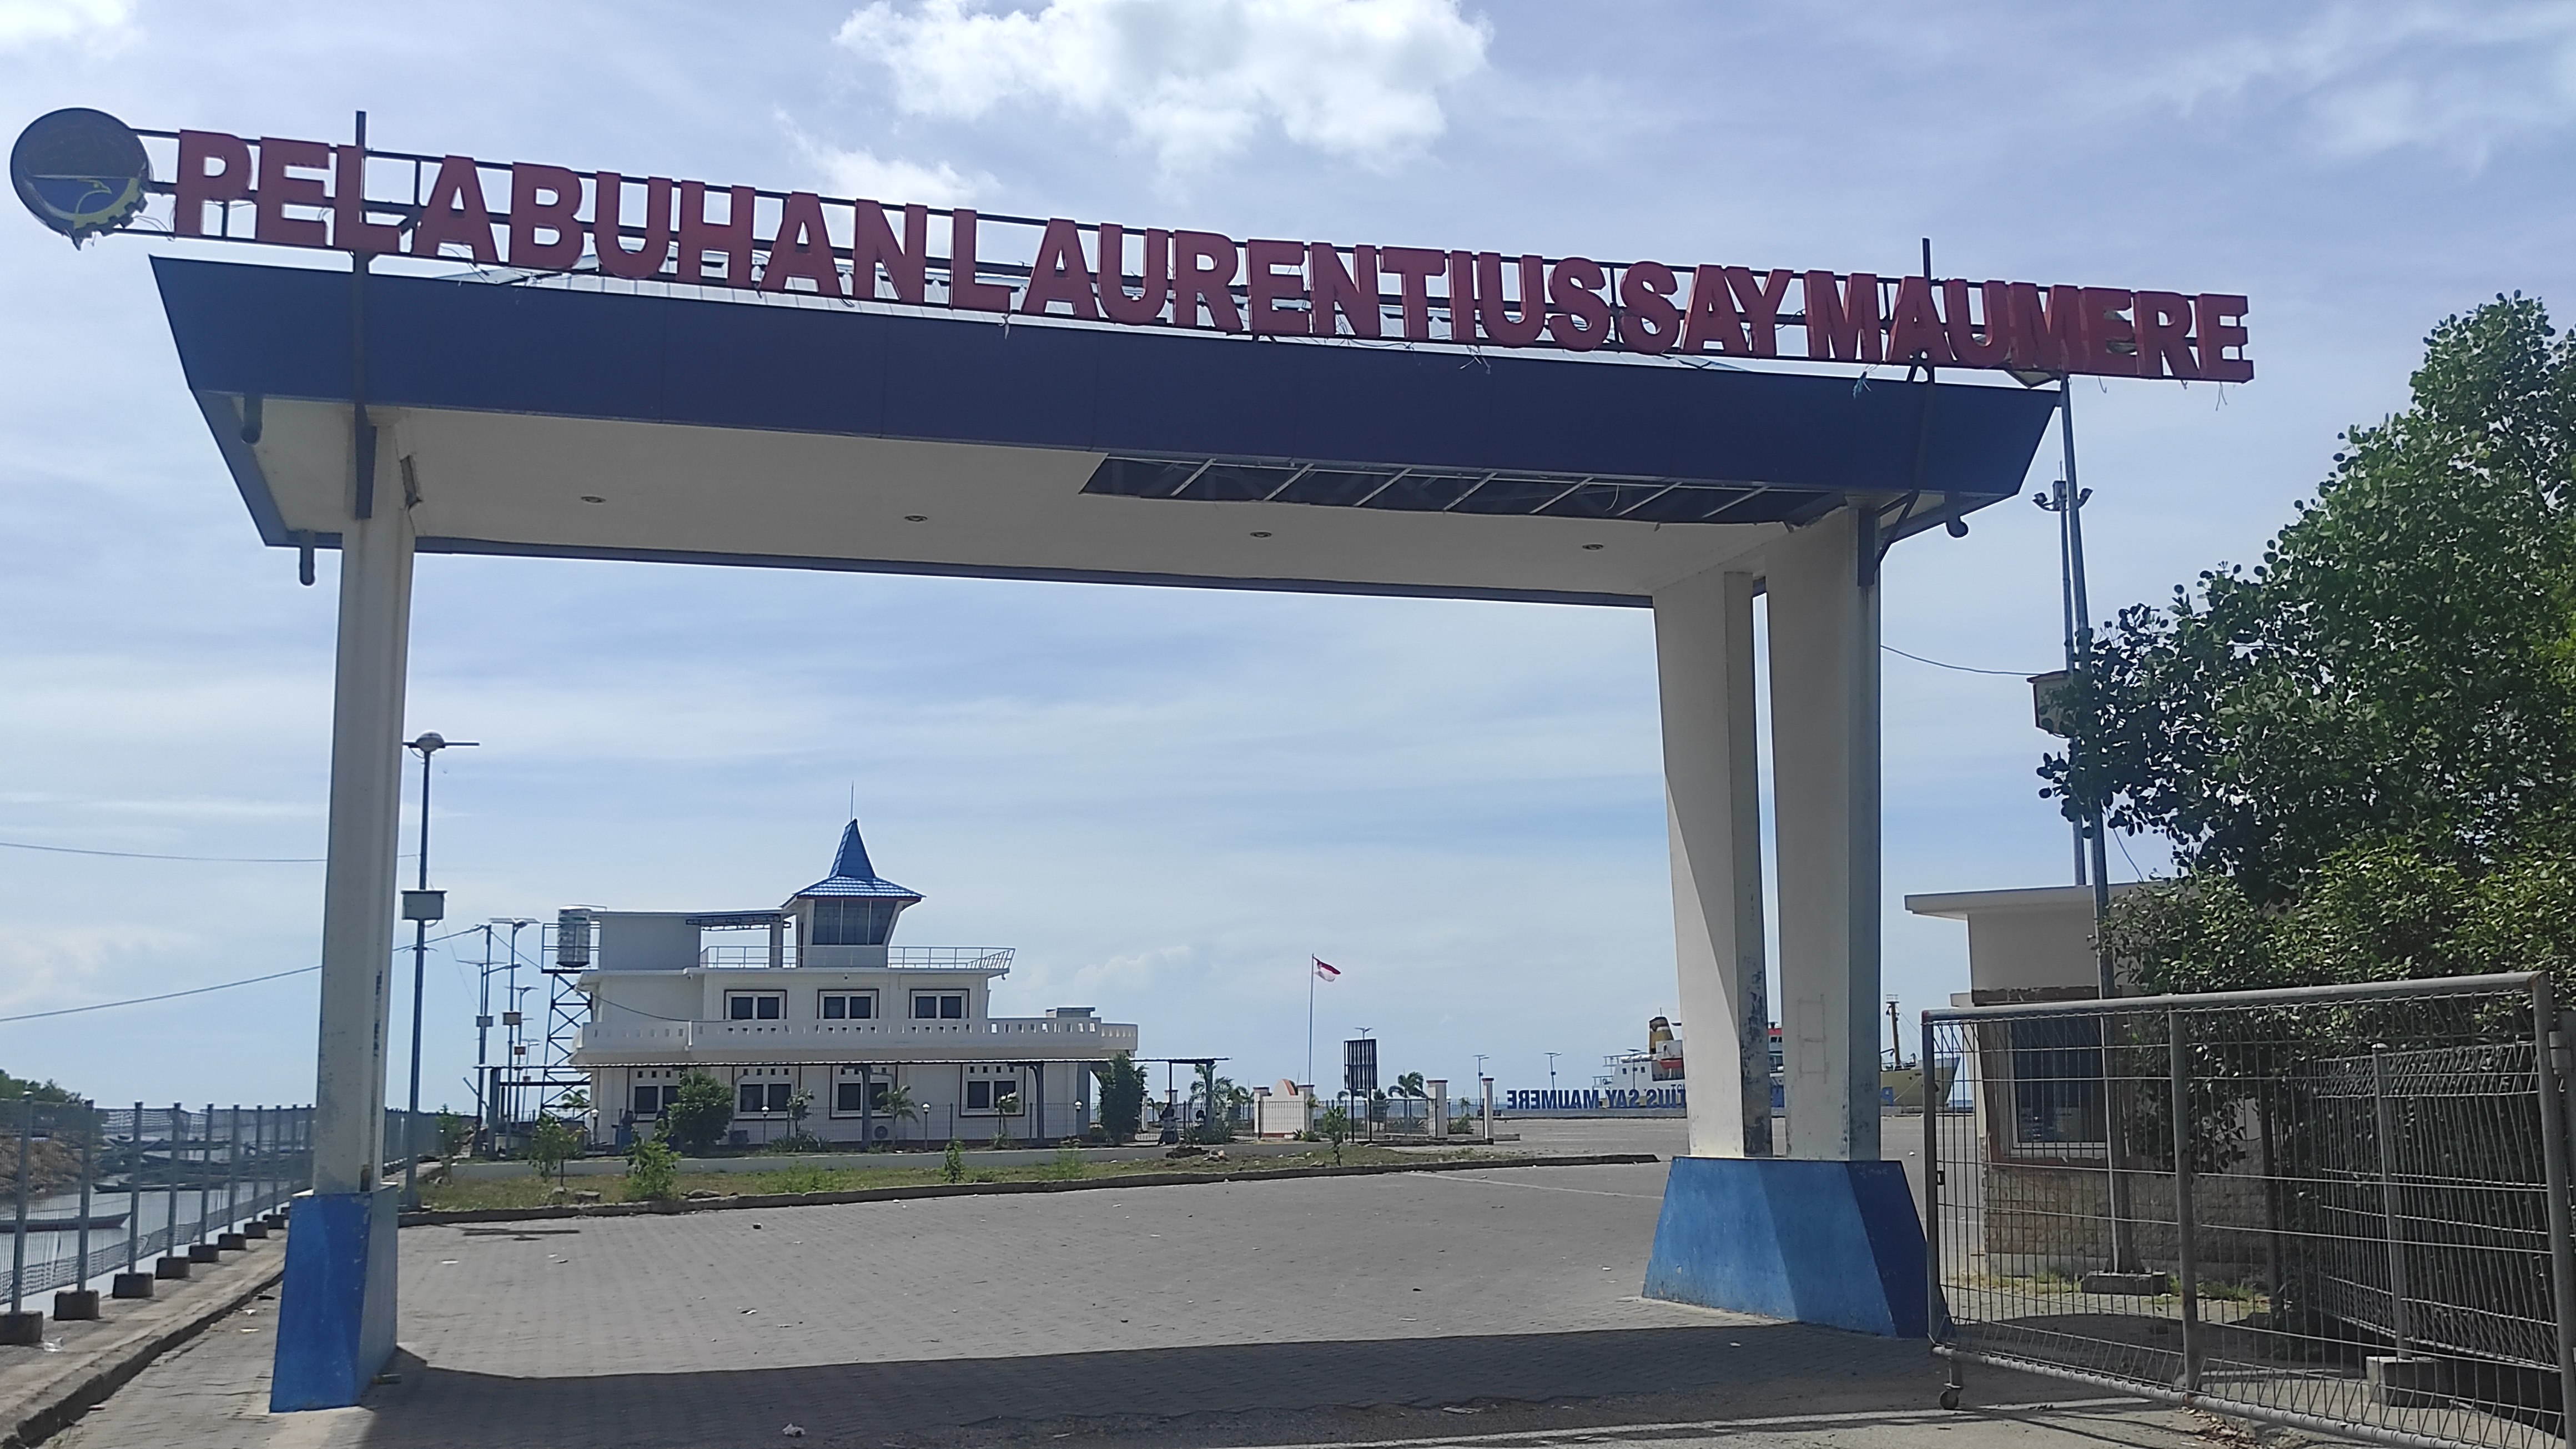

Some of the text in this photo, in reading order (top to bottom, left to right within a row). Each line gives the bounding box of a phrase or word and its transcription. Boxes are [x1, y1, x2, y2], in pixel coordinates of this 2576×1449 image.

[173, 128, 2254, 383] PELABUHAN LAURENTIUS SAY MAUMERE
